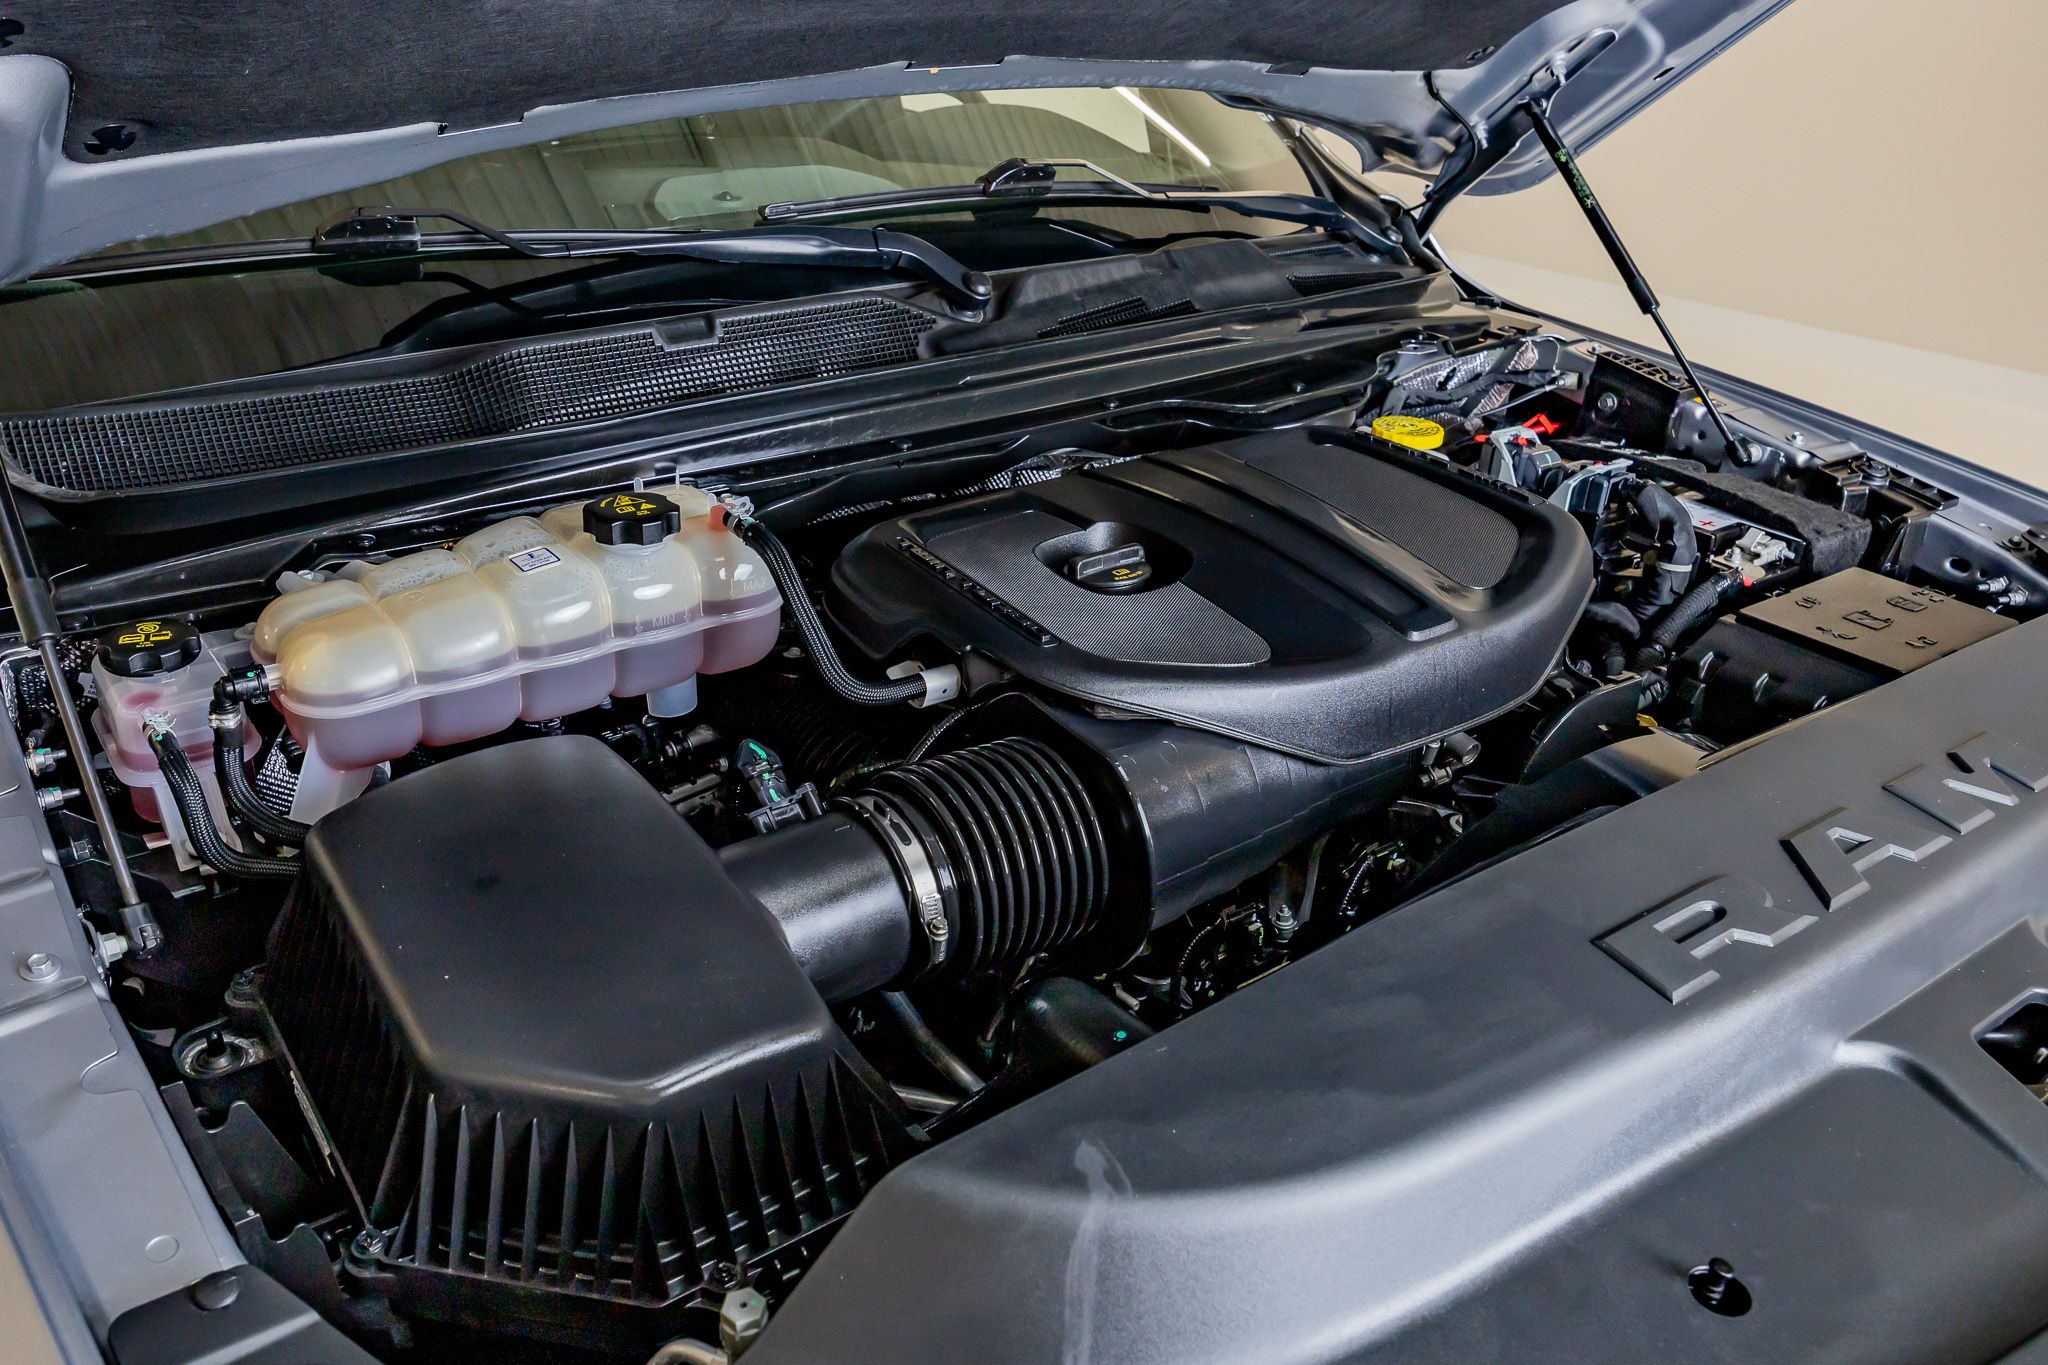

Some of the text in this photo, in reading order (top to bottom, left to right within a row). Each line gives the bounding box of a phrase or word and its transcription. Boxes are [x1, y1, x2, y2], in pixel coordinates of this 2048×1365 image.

[743, 576, 769, 593] MAX
[652, 612, 676, 628] MIN
[1590, 731, 2048, 1005] RAM
